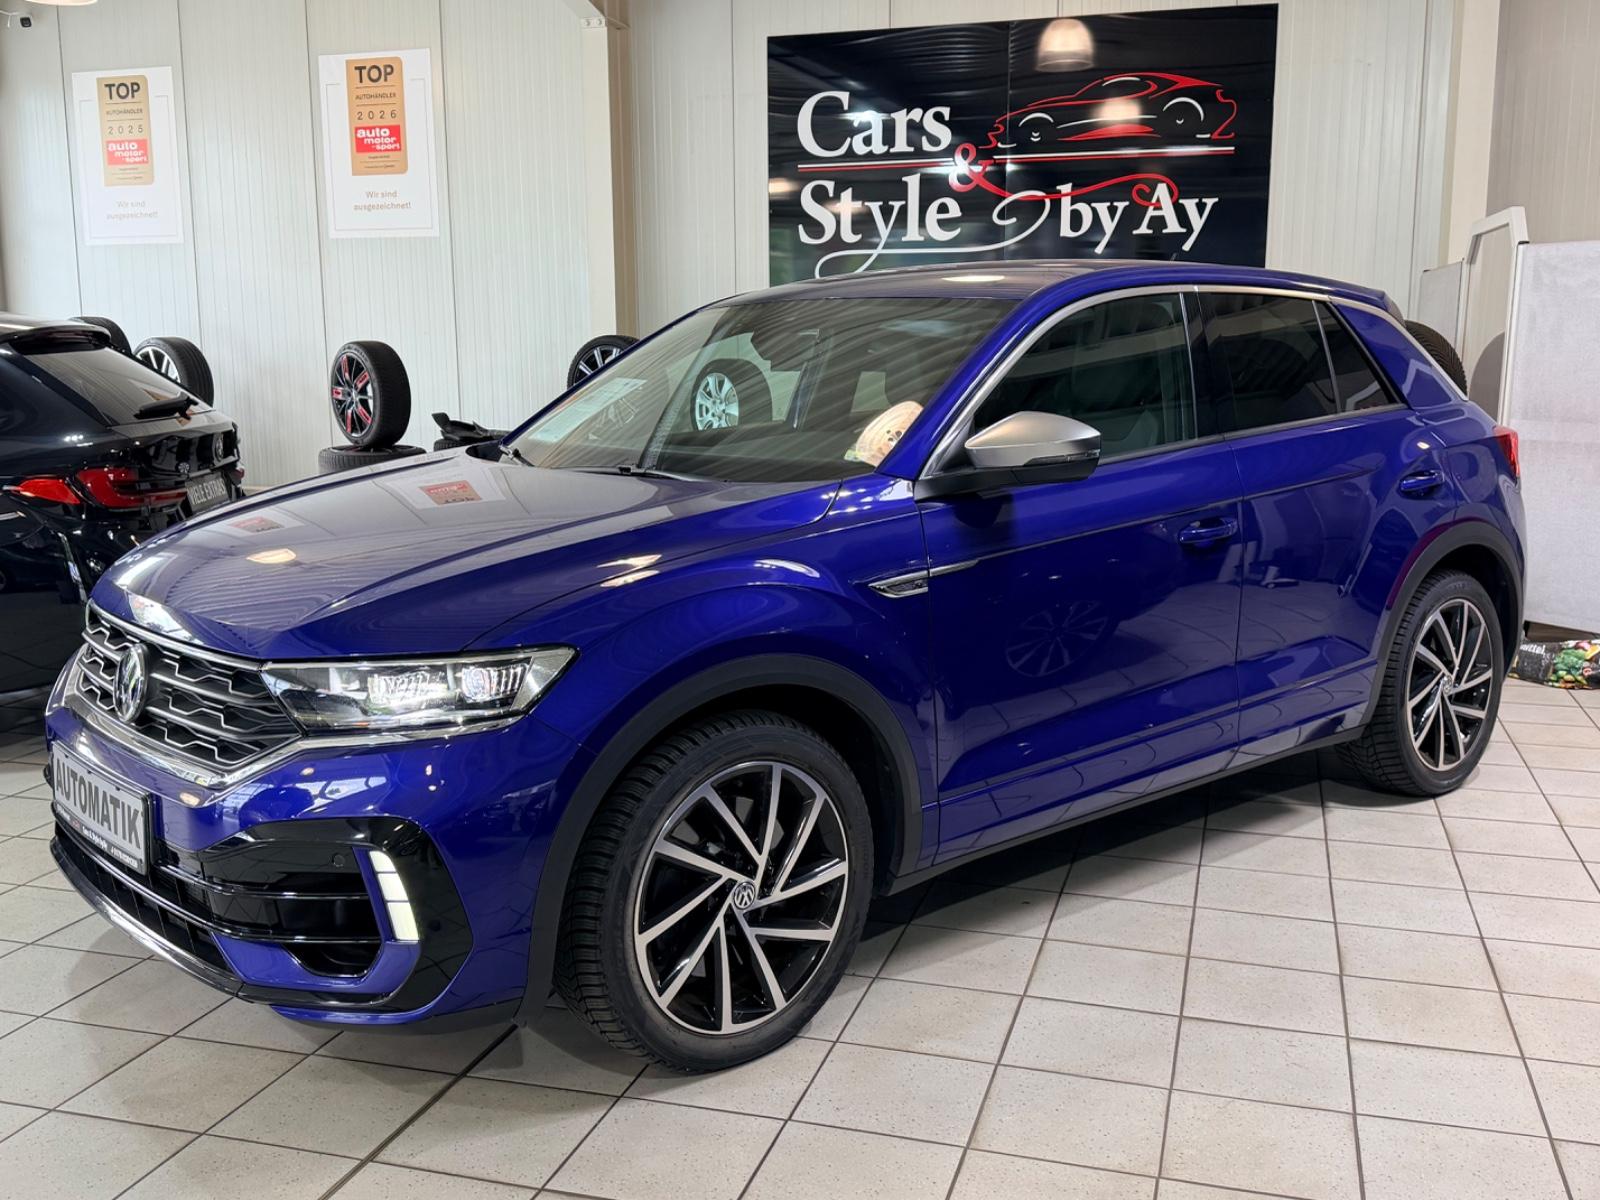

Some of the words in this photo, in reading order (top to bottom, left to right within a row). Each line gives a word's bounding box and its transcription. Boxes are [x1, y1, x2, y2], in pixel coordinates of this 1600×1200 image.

[355, 64, 394, 83] TOP
[104, 82, 141, 101] TOP
[357, 110, 397, 121] 2026
[108, 125, 144, 135] 2025
[797, 91, 953, 159] Cars
[356, 128, 390, 138] auto
[364, 136, 396, 144] motor
[108, 141, 138, 151] auto
[366, 191, 380, 199] Wir
[381, 190, 398, 198] sind
[354, 202, 412, 212] ausgezeichnet!
[797, 174, 963, 258] Style
[1058, 183, 1129, 255] by
[1132, 181, 1219, 253] Ay
[56, 757, 142, 850] AUTOMATIK
